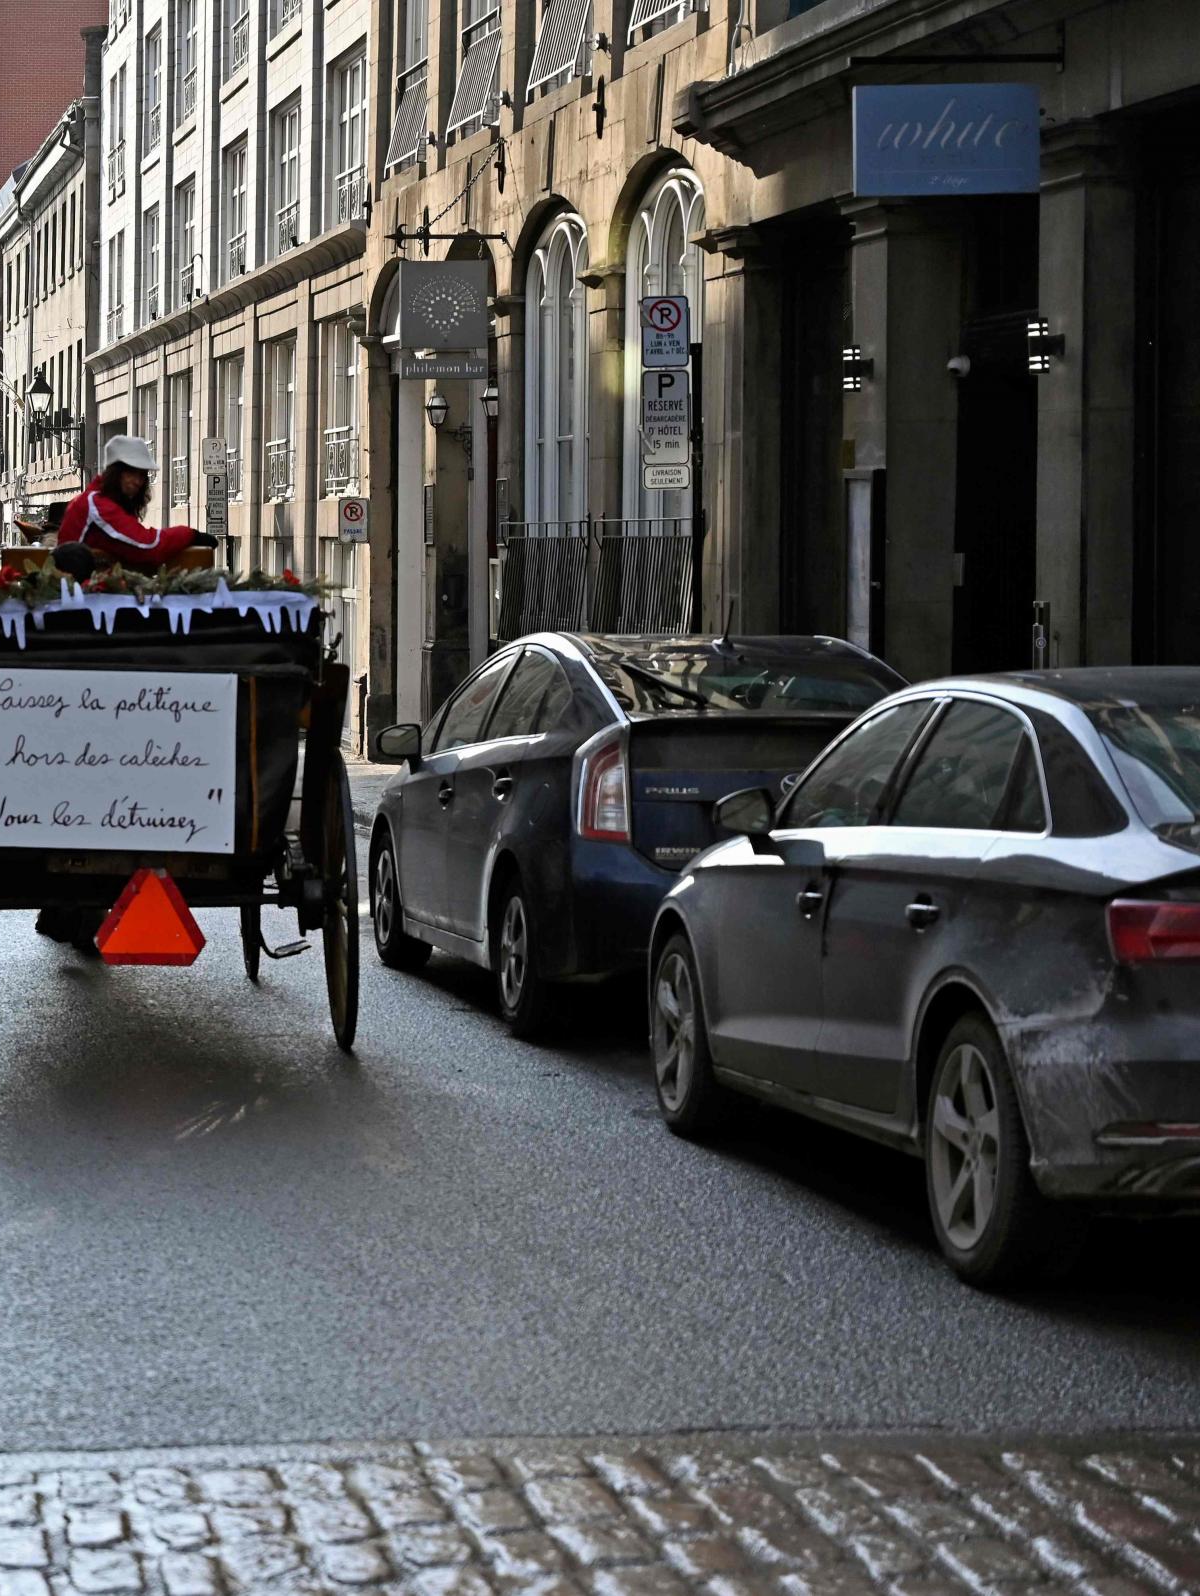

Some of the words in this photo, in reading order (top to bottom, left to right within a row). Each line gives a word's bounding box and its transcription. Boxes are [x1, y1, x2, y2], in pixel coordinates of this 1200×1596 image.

[405, 362, 460, 376] philemon
[465, 362, 485, 373] bar
[658, 374, 675, 398] P
[648, 399, 684, 411] RÉSERVÉ
[657, 424, 683, 436] HÔTEL
[653, 439, 661, 449] 15
[664, 439, 681, 448] min
[652, 468, 682, 477] LIVRAISON
[650, 477, 683, 485] SEULEMENT
[78, 687, 106, 710] la
[114, 687, 219, 723] politique
[5, 734, 71, 767] hors
[74, 742, 114, 767] des
[645, 786, 699, 794] PRIUS
[51, 800, 92, 826] les
